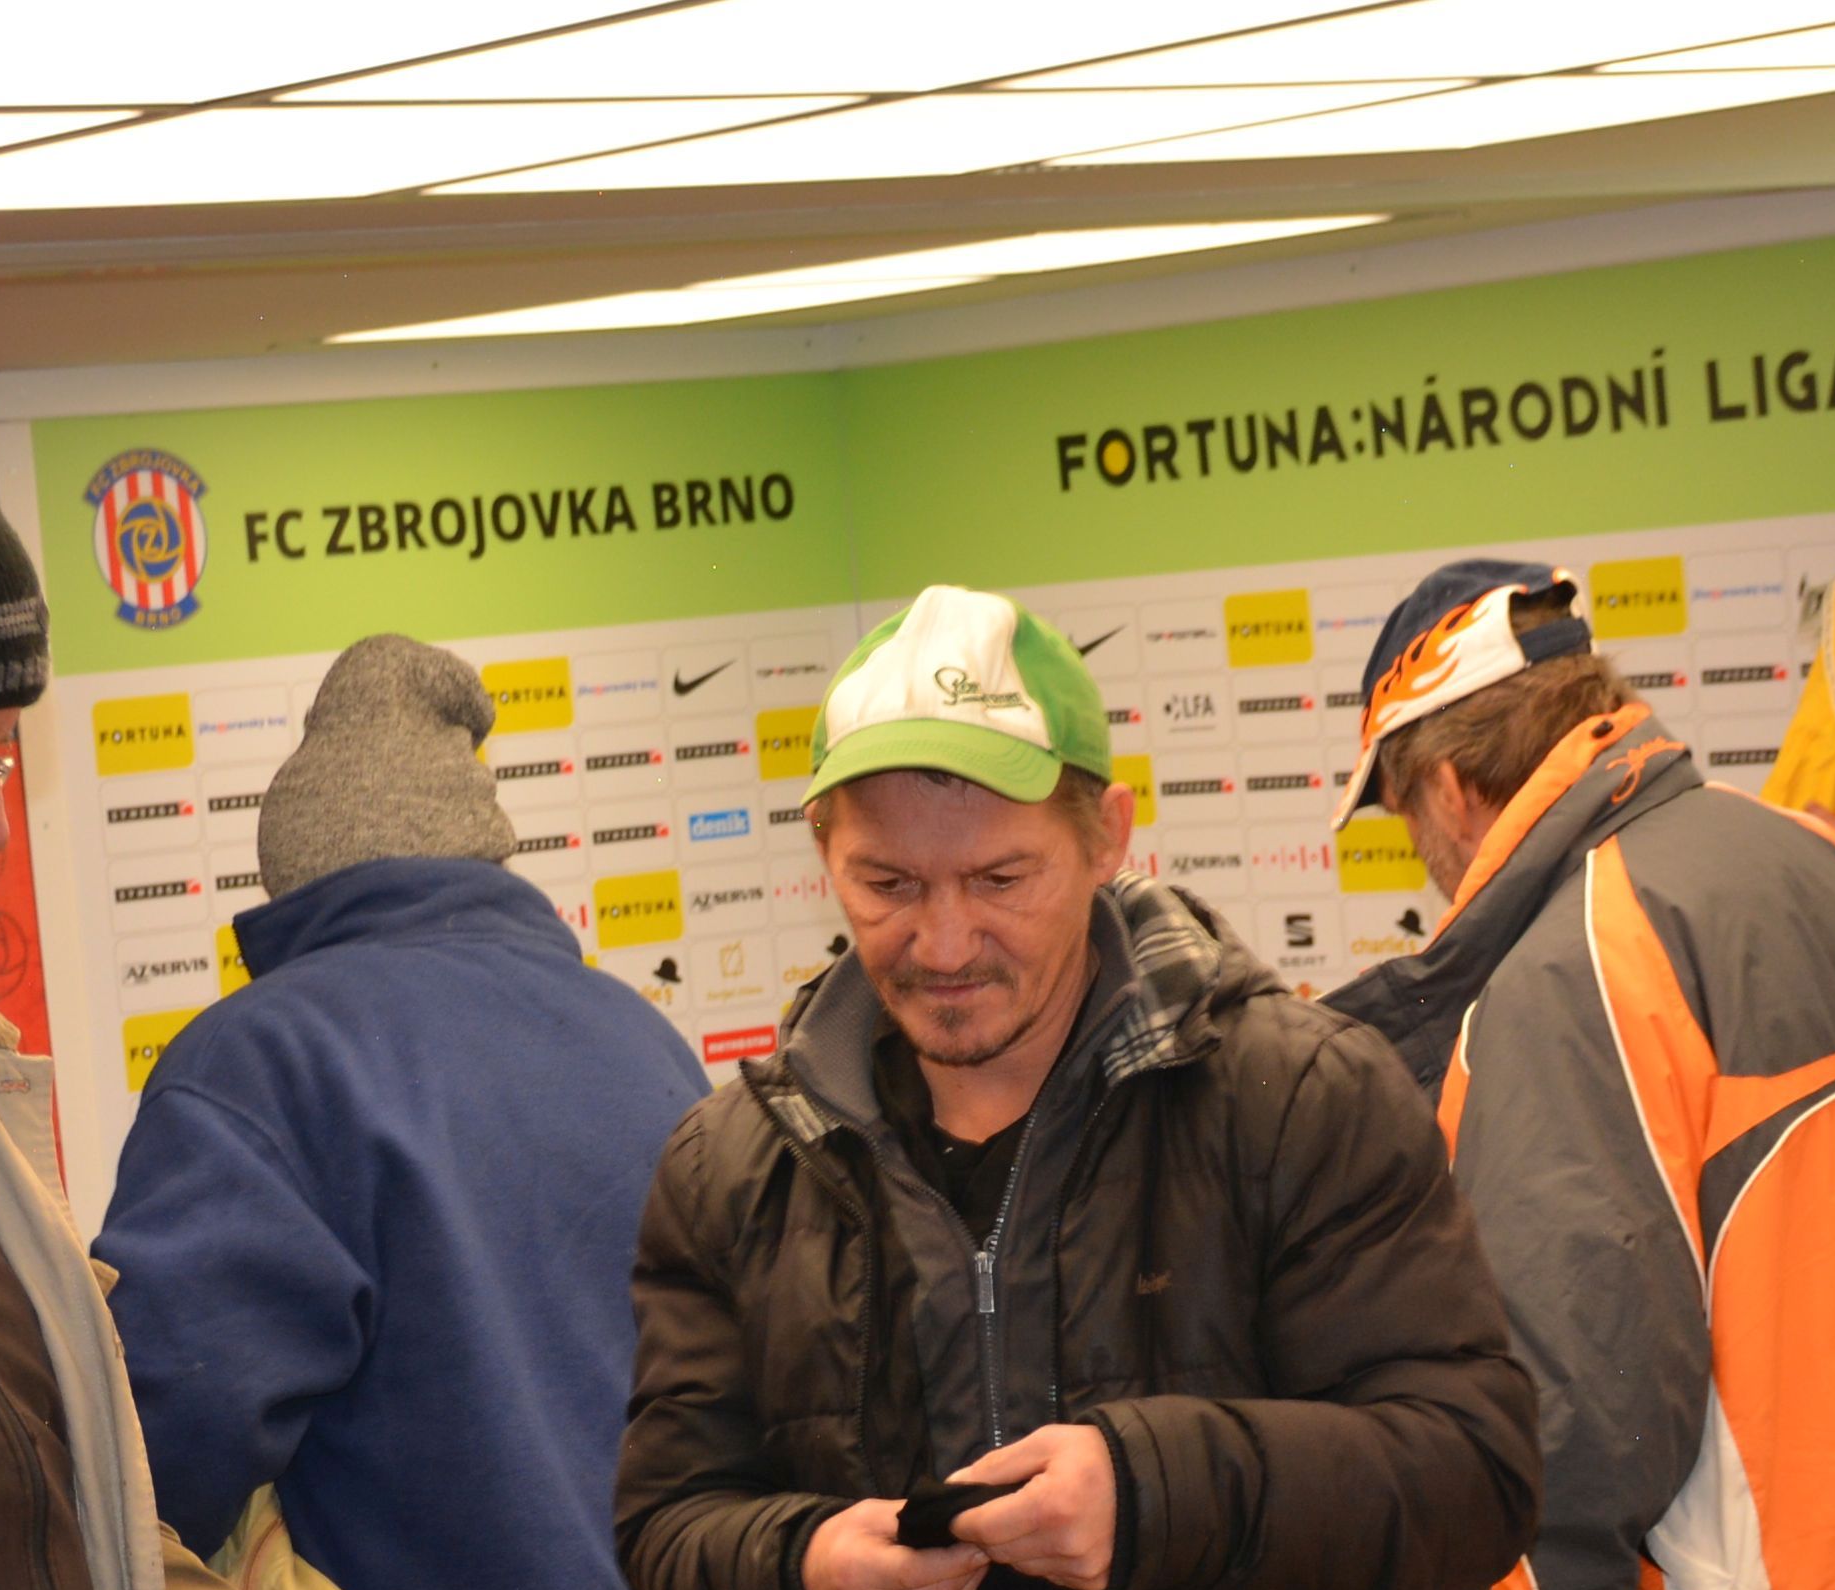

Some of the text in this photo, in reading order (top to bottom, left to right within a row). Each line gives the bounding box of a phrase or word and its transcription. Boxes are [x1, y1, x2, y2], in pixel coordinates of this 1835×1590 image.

[244, 472, 795, 563] FC ZBROJOVKA BRNO
[99, 723, 187, 746] FORTUNA
